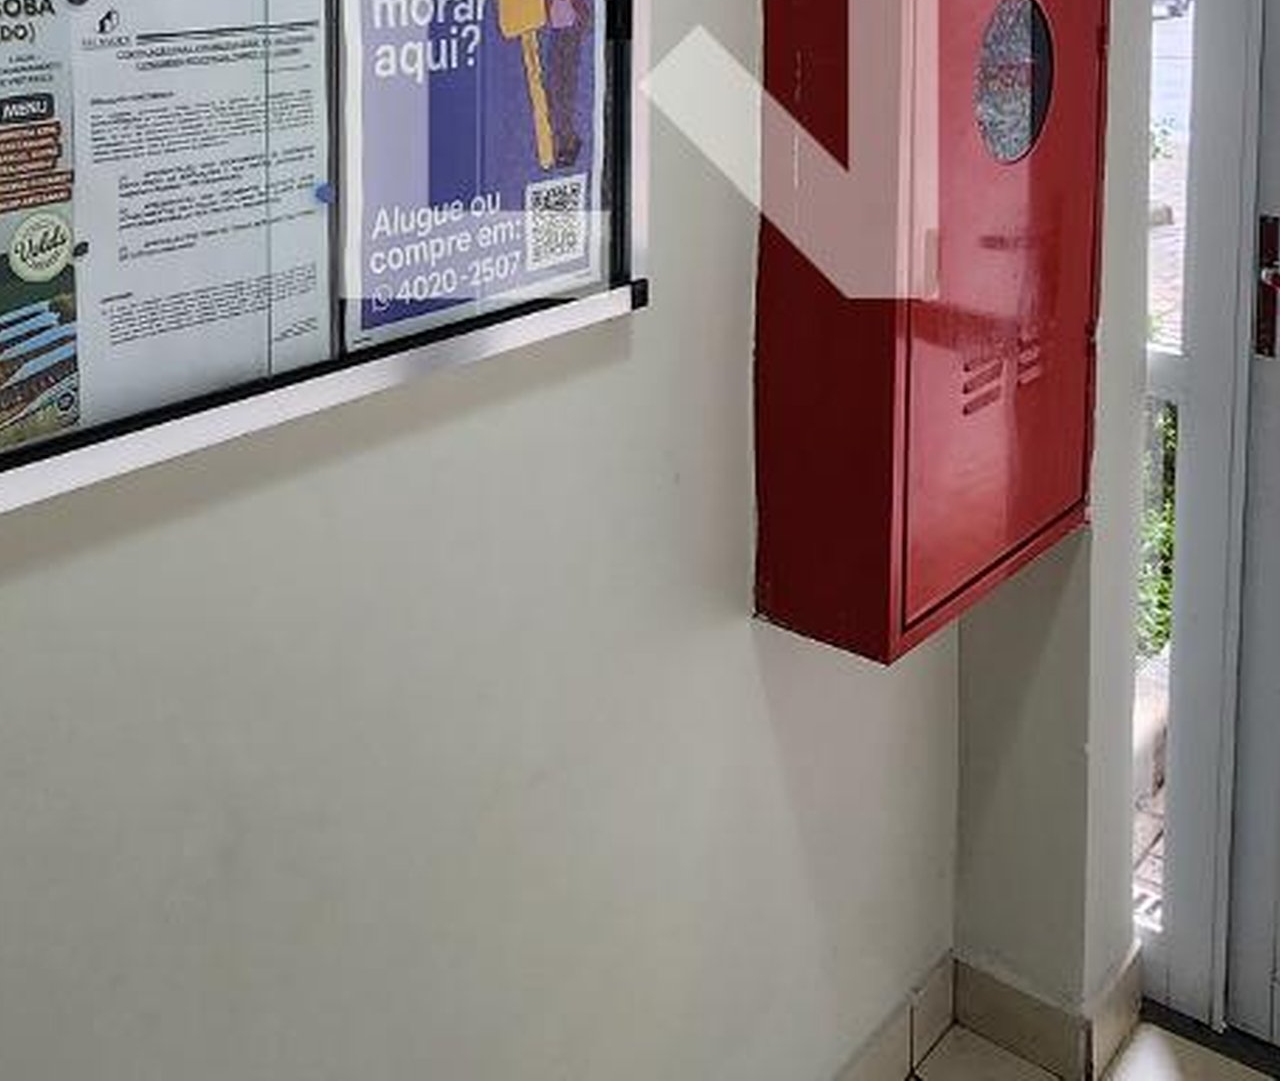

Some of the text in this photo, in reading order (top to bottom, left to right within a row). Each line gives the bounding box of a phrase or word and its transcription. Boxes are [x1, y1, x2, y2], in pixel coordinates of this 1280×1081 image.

[373, 25, 480, 83] aqui?
[371, 192, 501, 241] Alugue ou
[370, 220, 522, 274] compre em:
[396, 251, 521, 304] 4020-2507
